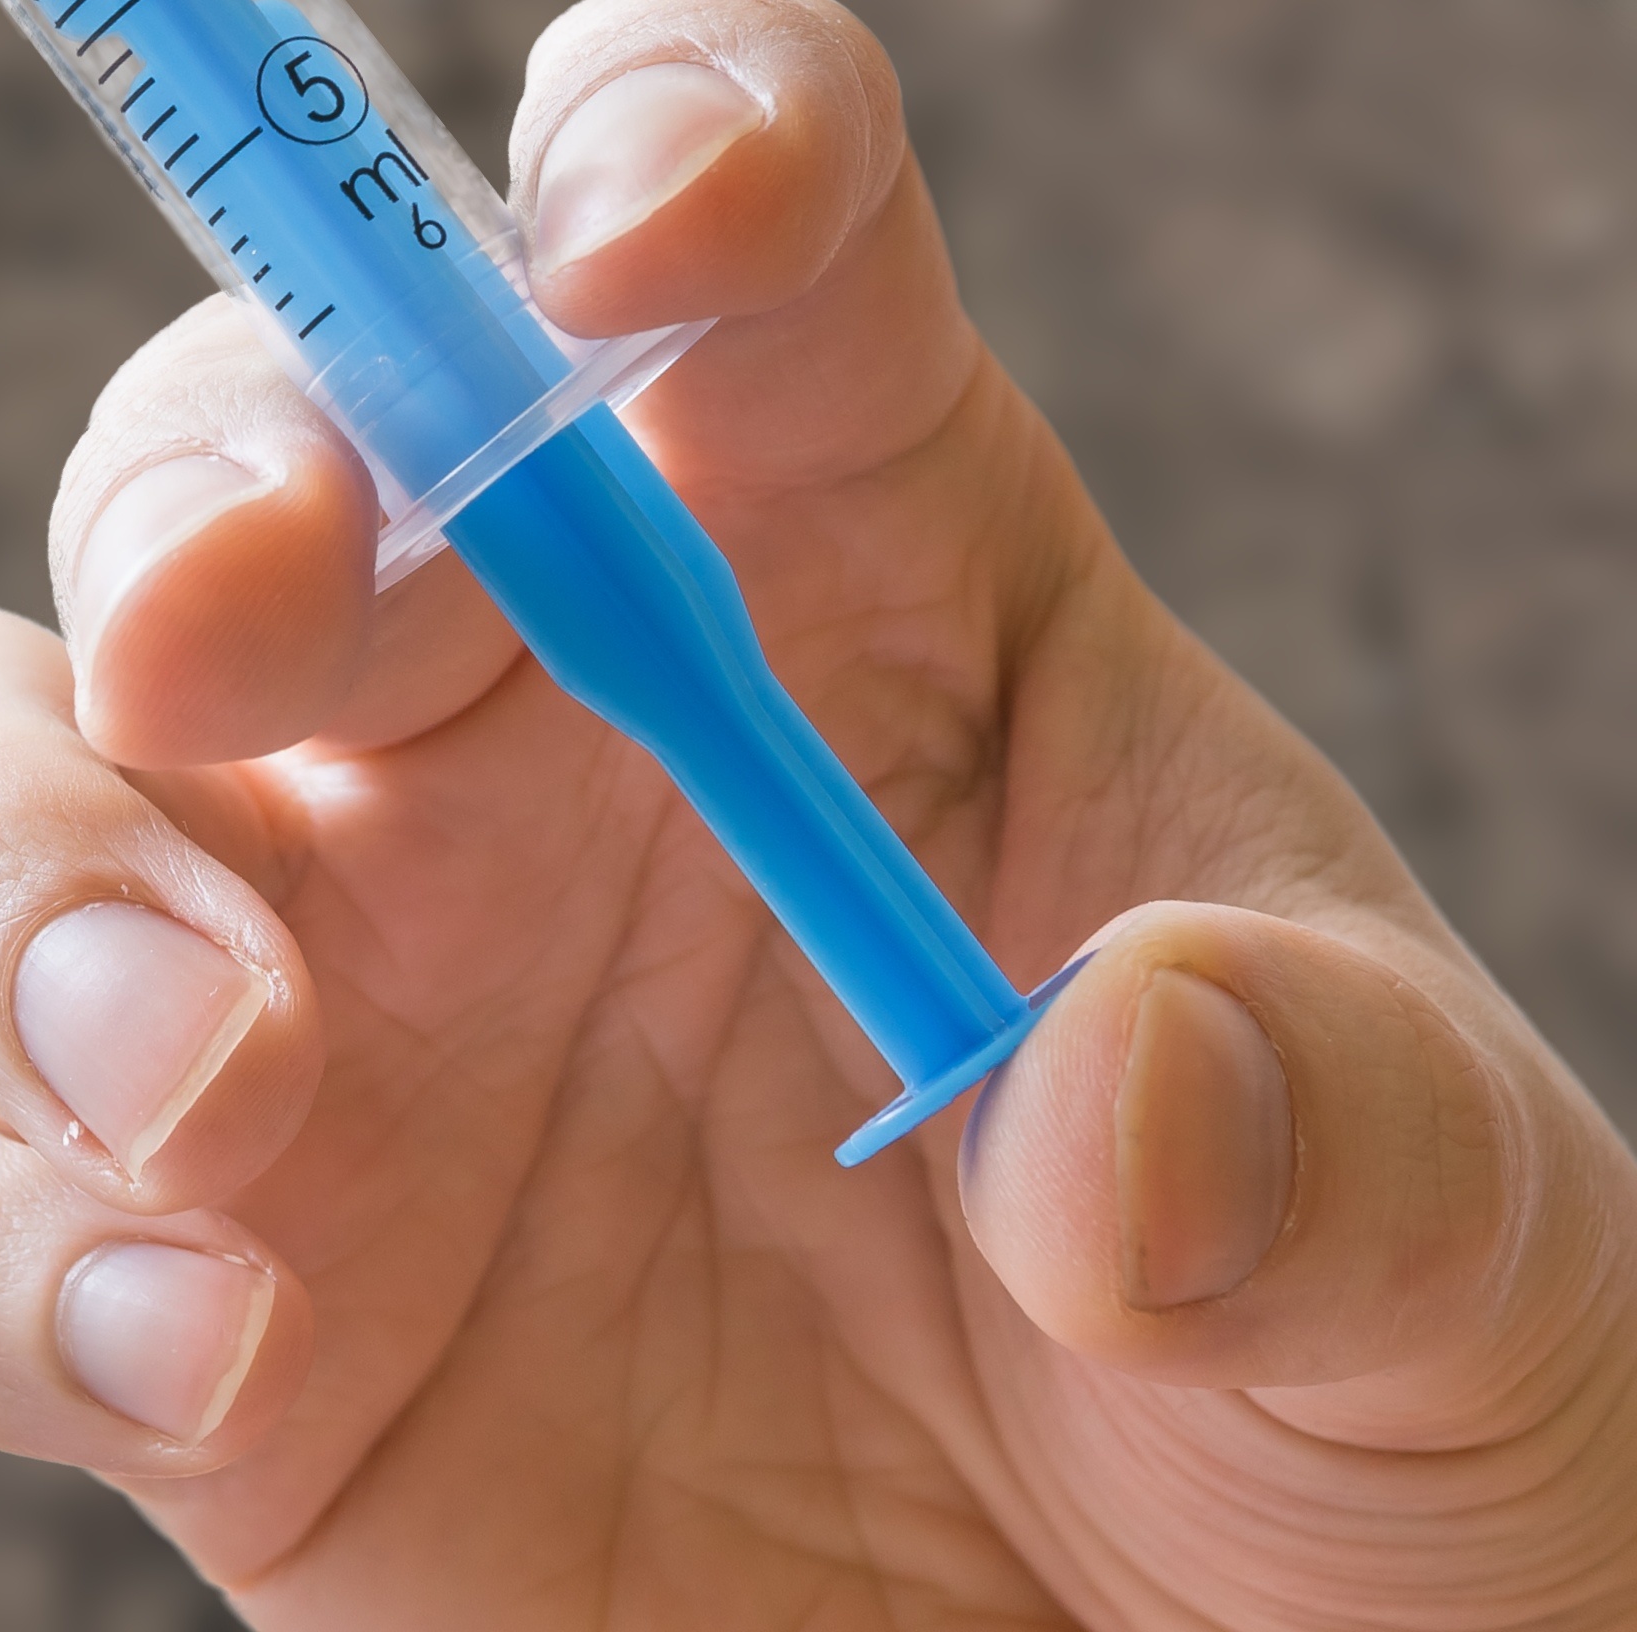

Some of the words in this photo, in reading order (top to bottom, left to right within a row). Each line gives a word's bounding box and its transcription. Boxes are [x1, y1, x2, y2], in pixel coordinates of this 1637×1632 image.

[283, 50, 346, 124] 5
[339, 128, 430, 222] ml
[411, 201, 448, 250] 6
